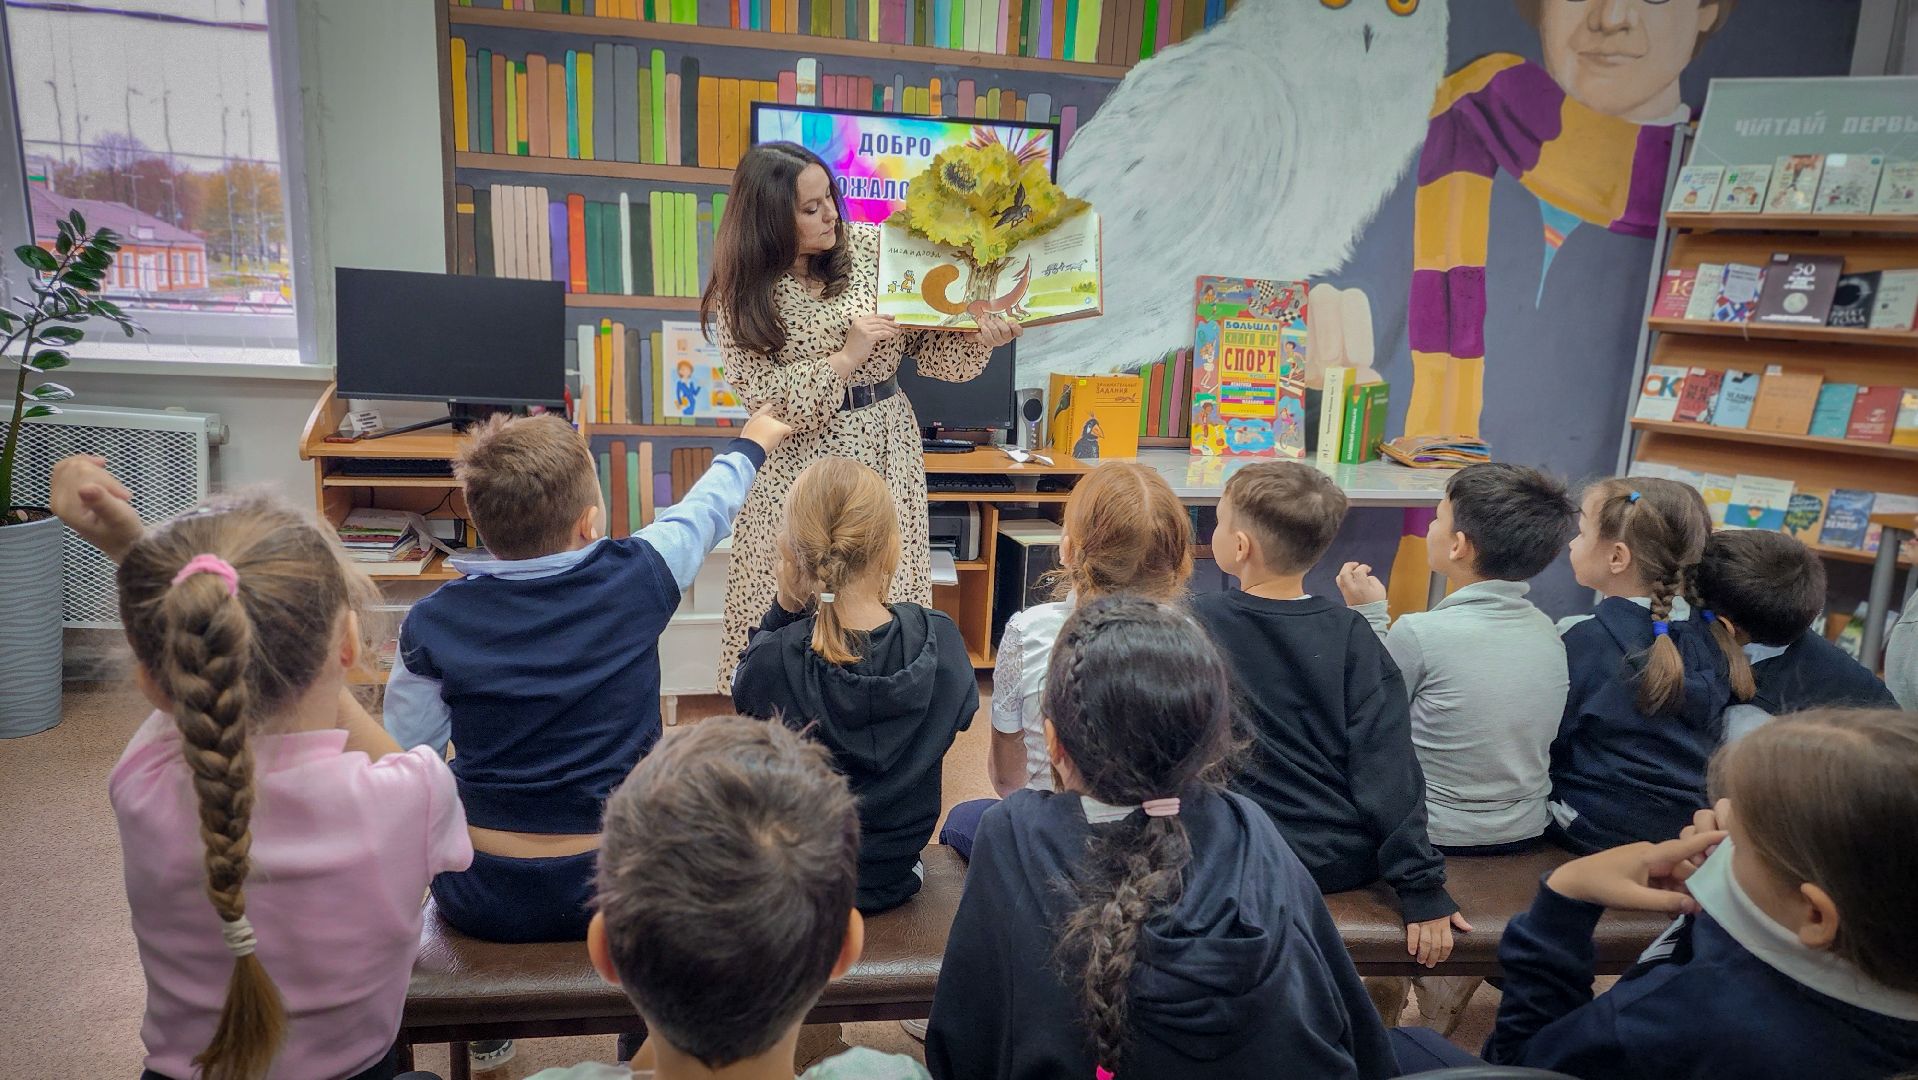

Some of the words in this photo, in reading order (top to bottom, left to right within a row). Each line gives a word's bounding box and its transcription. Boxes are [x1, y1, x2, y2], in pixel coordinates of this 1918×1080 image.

[1735, 109, 1827, 137] ЧИТАЙ
[858, 132, 931, 157] ДОБРО
[837, 176, 909, 200] ОЖАЛО
[1225, 320, 1278, 332] БОЛЬШАЯ
[1259, 333, 1278, 346] ИГР
[1224, 347, 1276, 373] СПОРТ
